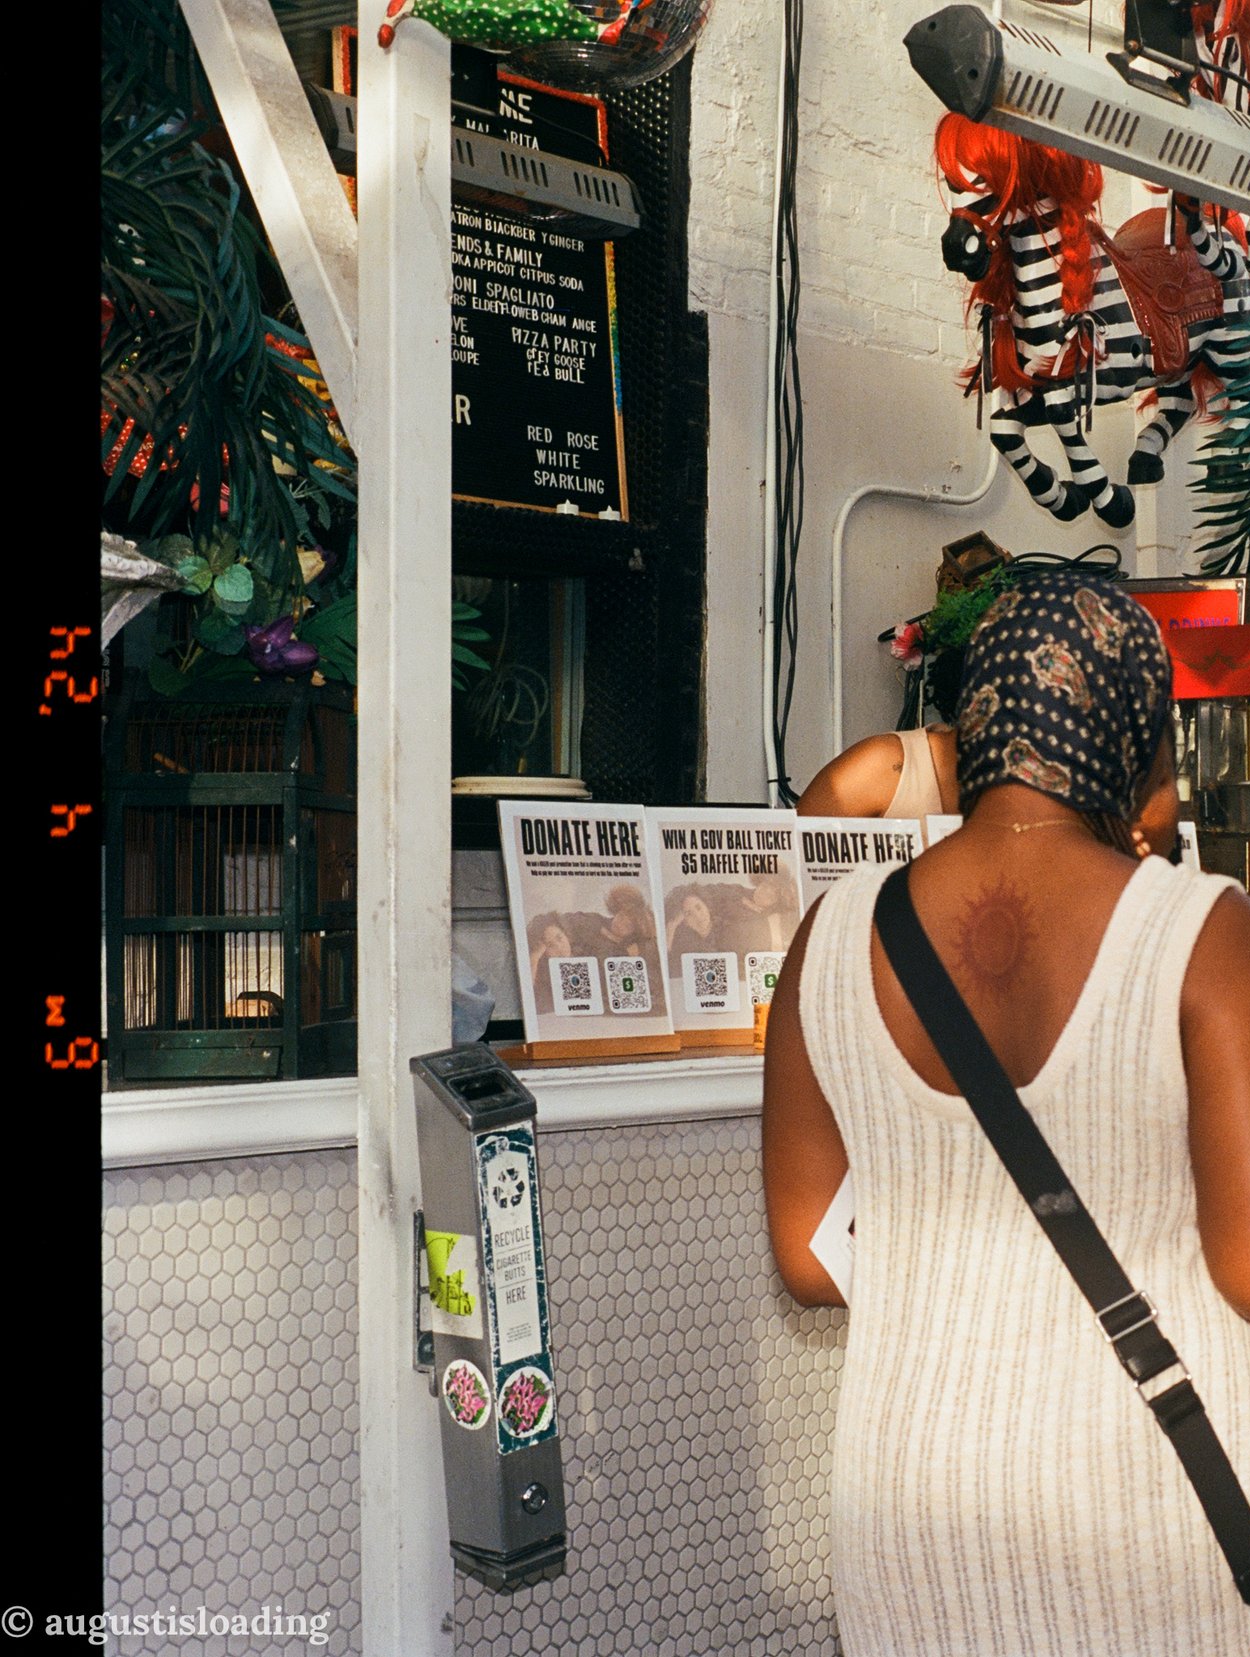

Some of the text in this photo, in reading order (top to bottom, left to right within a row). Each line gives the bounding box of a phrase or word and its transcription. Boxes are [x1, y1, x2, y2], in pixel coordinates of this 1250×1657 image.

[550, 232, 585, 252] GINGER
[484, 240, 494, 256] &
[497, 243, 543, 268] FAMILY
[452, 275, 555, 309] ONI SPAGLIATO
[559, 275, 584, 292] SODA
[452, 315, 469, 333] VE
[572, 318, 598, 333] ANGE
[511, 326, 597, 358] PIZZA PARTY
[554, 354, 586, 370] GOOSE
[555, 368, 585, 384] BULL
[527, 425, 599, 451] RED ROSE
[536, 449, 581, 470] WHITE
[534, 470, 605, 494] SPARKLING
[521, 818, 641, 857] DONATE HERE
[662, 829, 792, 850] WIN A GOV BALL TICKET
[802, 832, 868, 863] DONATE
[681, 852, 778, 875] $5 RAFFLE TICKET
[568, 1003, 590, 1011] venmo
[494, 1225, 530, 1248] RECYCLE
[496, 1250, 532, 1270] CIGARETTE
[504, 1265, 526, 1281] BUTTS
[506, 1285, 527, 1304] HERE
